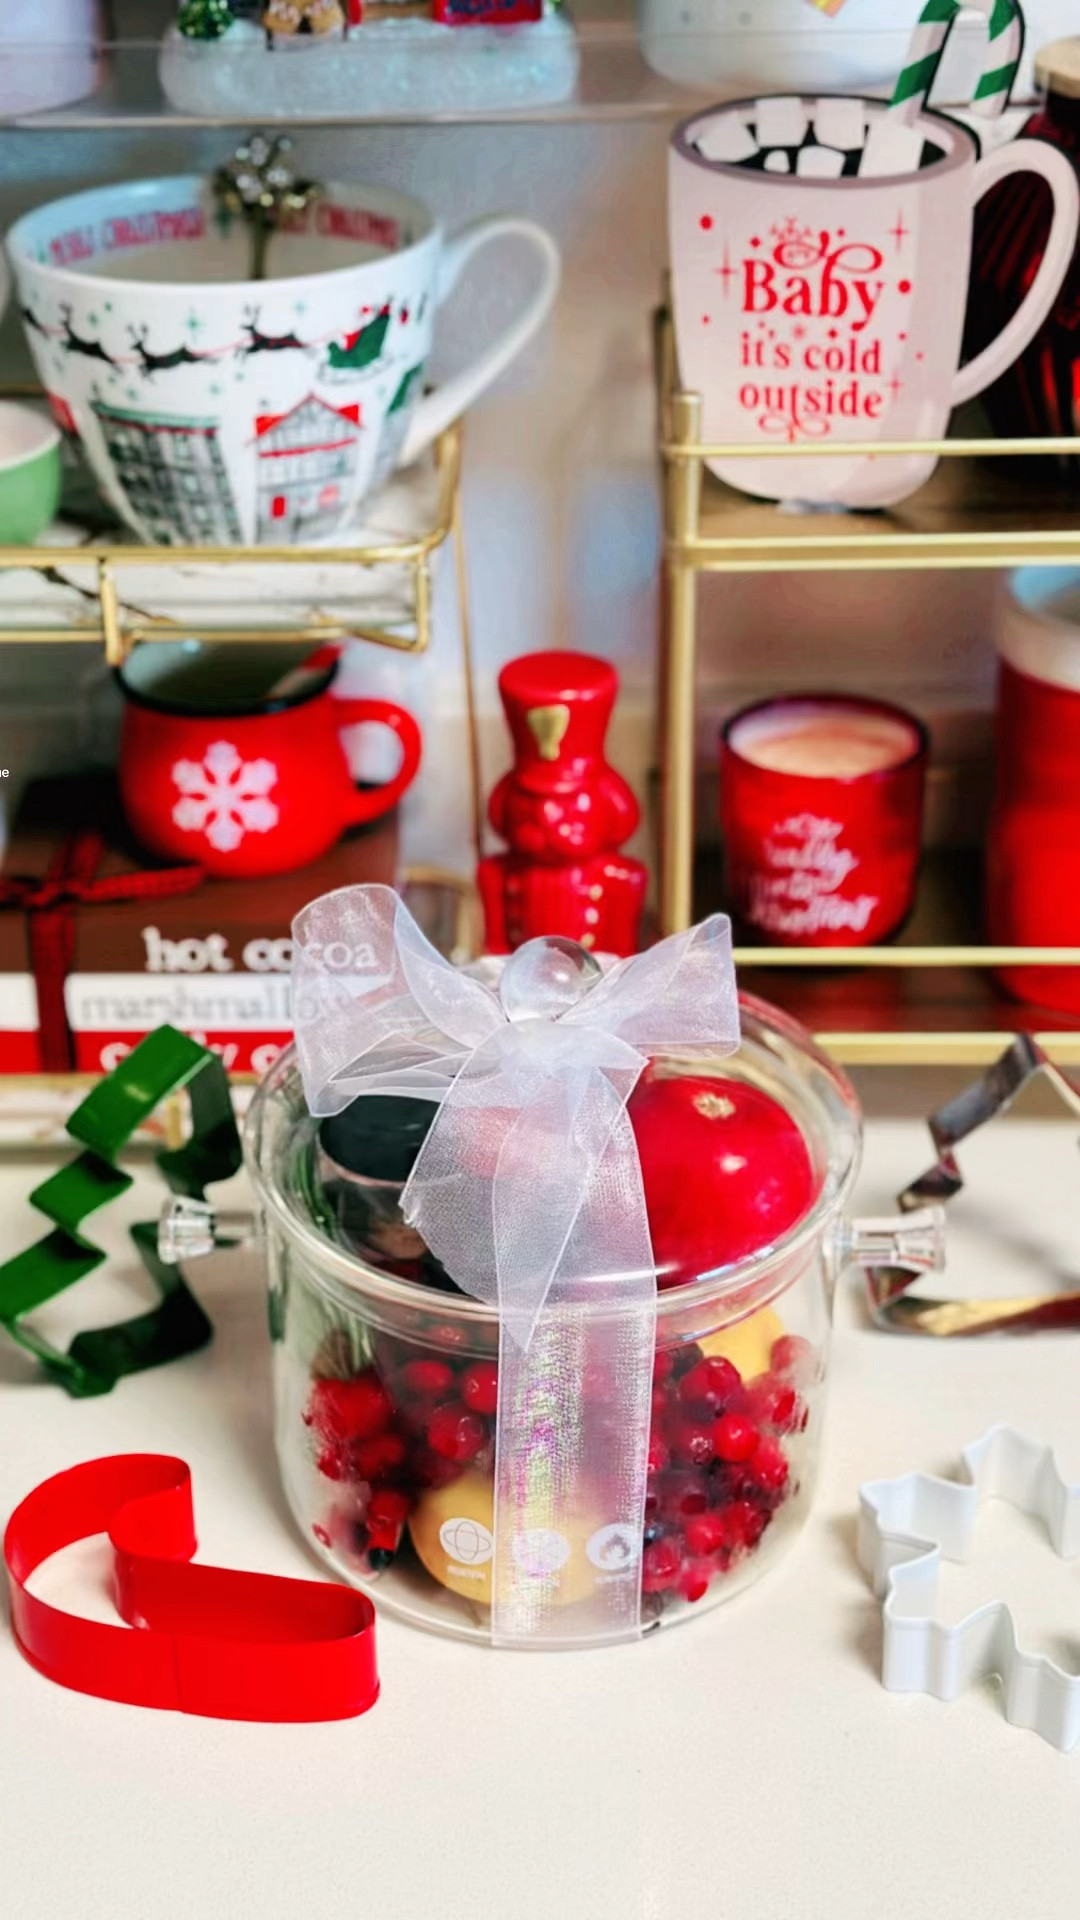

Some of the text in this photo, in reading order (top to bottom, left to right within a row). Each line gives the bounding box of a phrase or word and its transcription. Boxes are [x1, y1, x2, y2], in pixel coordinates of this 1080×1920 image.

[742, 231, 884, 332] Baby
[803, 337, 881, 375] cold
[739, 380, 883, 442] outside
[142, 925, 380, 973] hot cocoa
